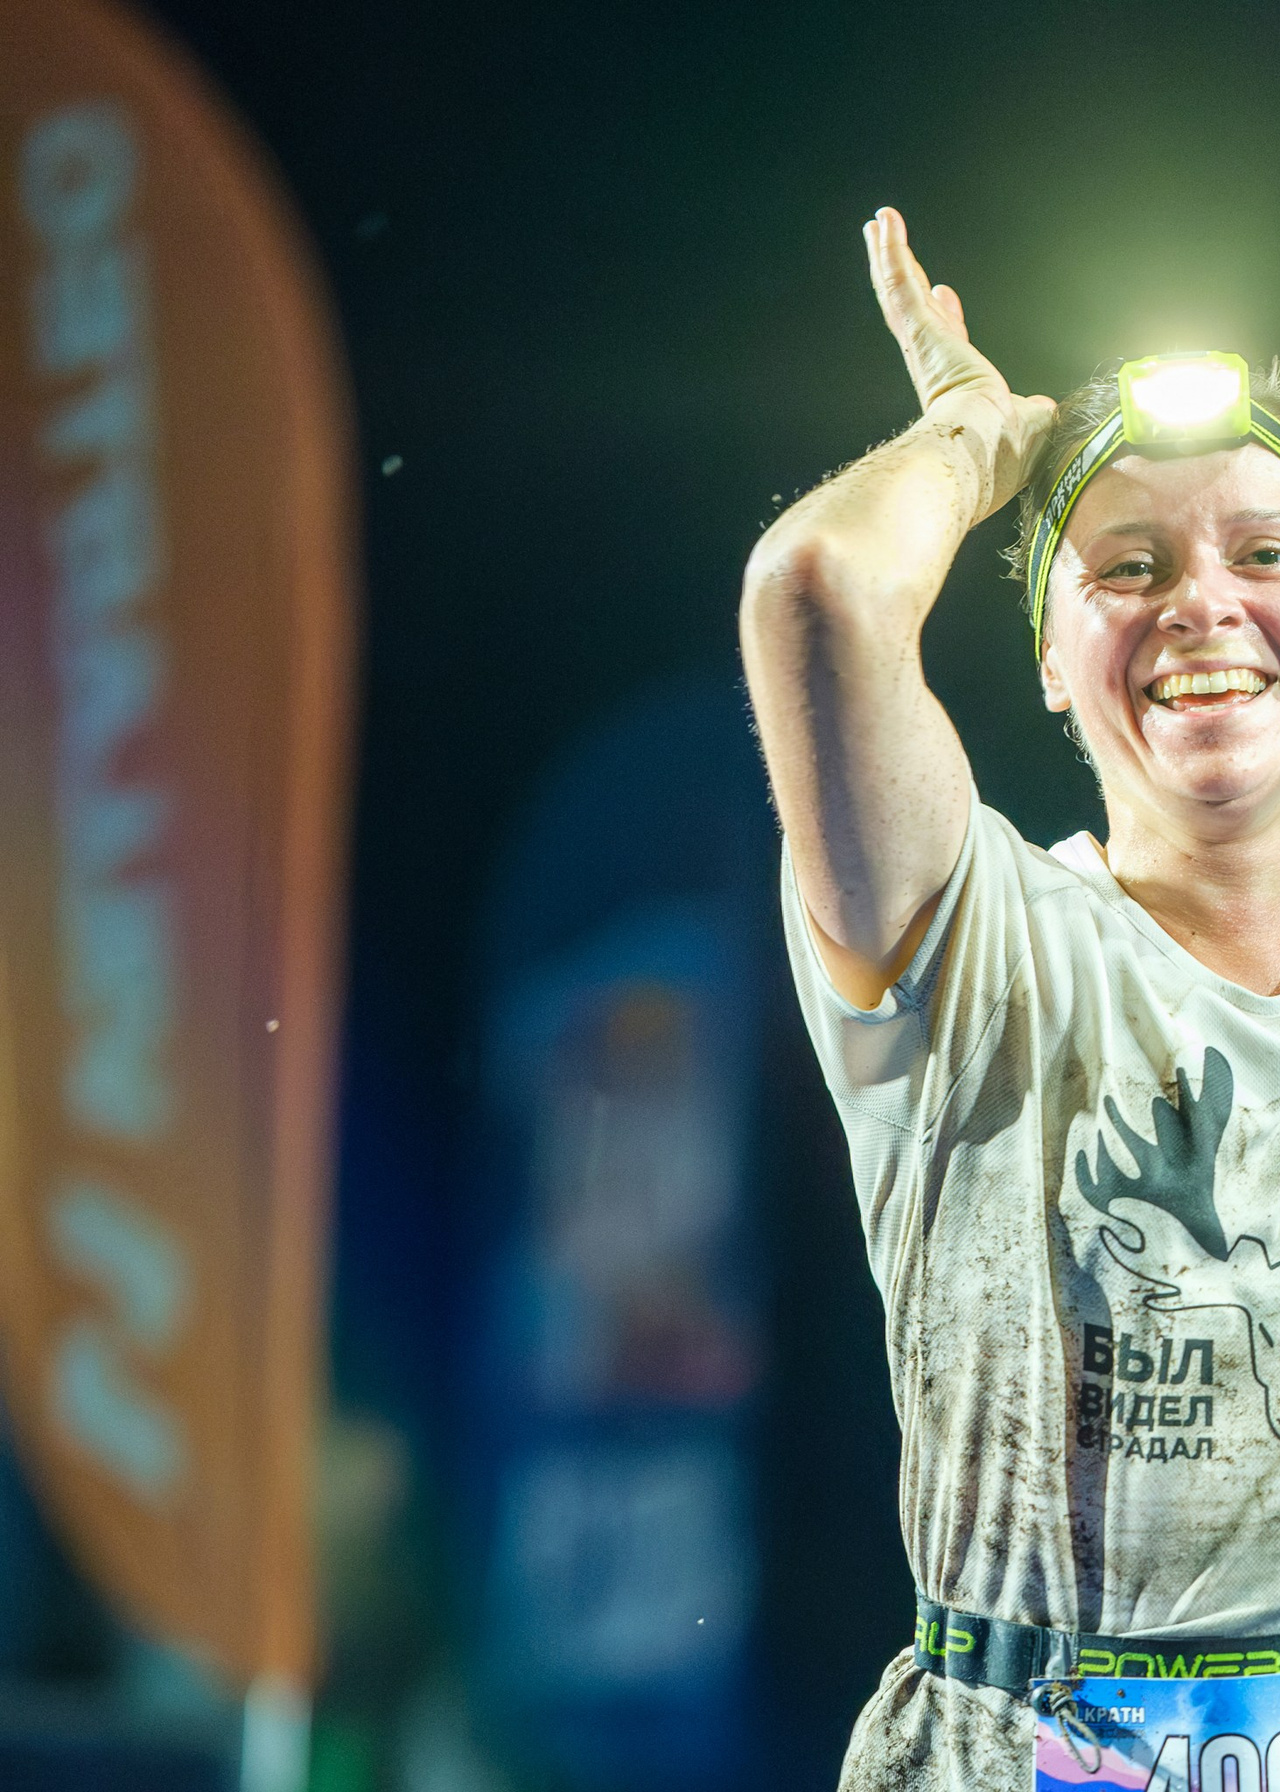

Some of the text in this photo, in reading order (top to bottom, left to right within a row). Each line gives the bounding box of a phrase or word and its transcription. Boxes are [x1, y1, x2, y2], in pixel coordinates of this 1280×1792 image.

[1082, 1322, 1214, 1386] БЫЛ
[1080, 1383, 1214, 1432] ВИДЕЛ
[1067, 1706, 1145, 1723] LKPATH
